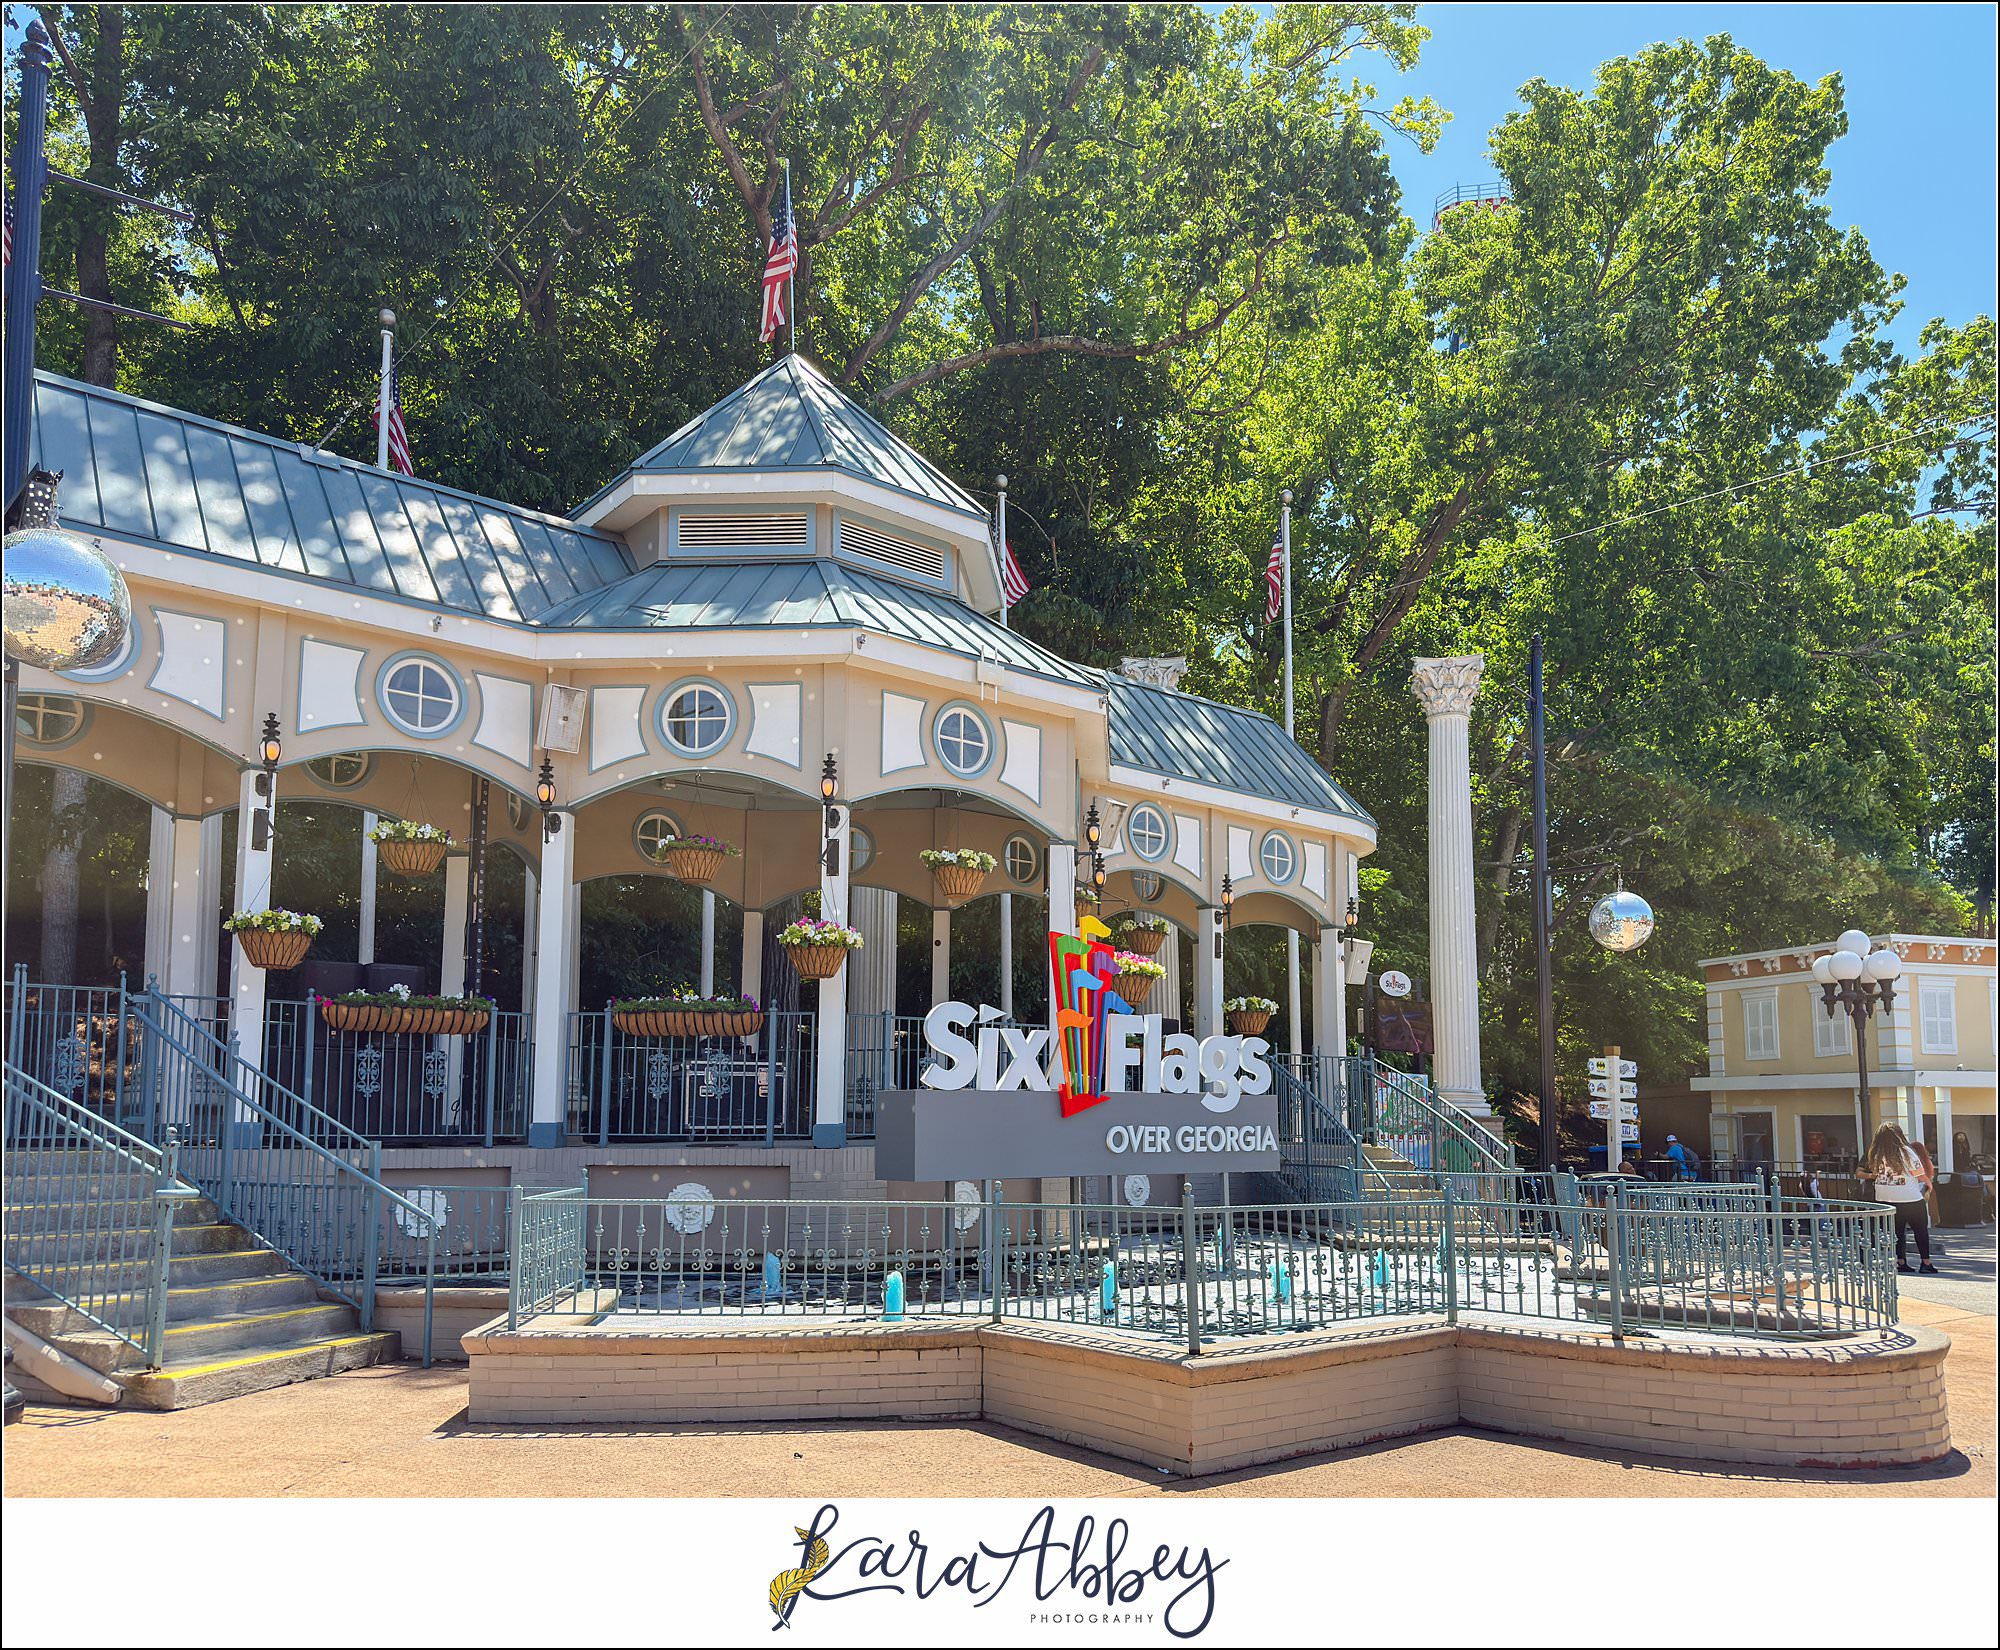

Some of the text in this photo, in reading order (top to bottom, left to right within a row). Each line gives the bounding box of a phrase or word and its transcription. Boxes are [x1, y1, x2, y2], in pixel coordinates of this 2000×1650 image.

[920, 1001, 1272, 1113] Six Flags
[1106, 1125, 1278, 1154] OVER GEORGIA
